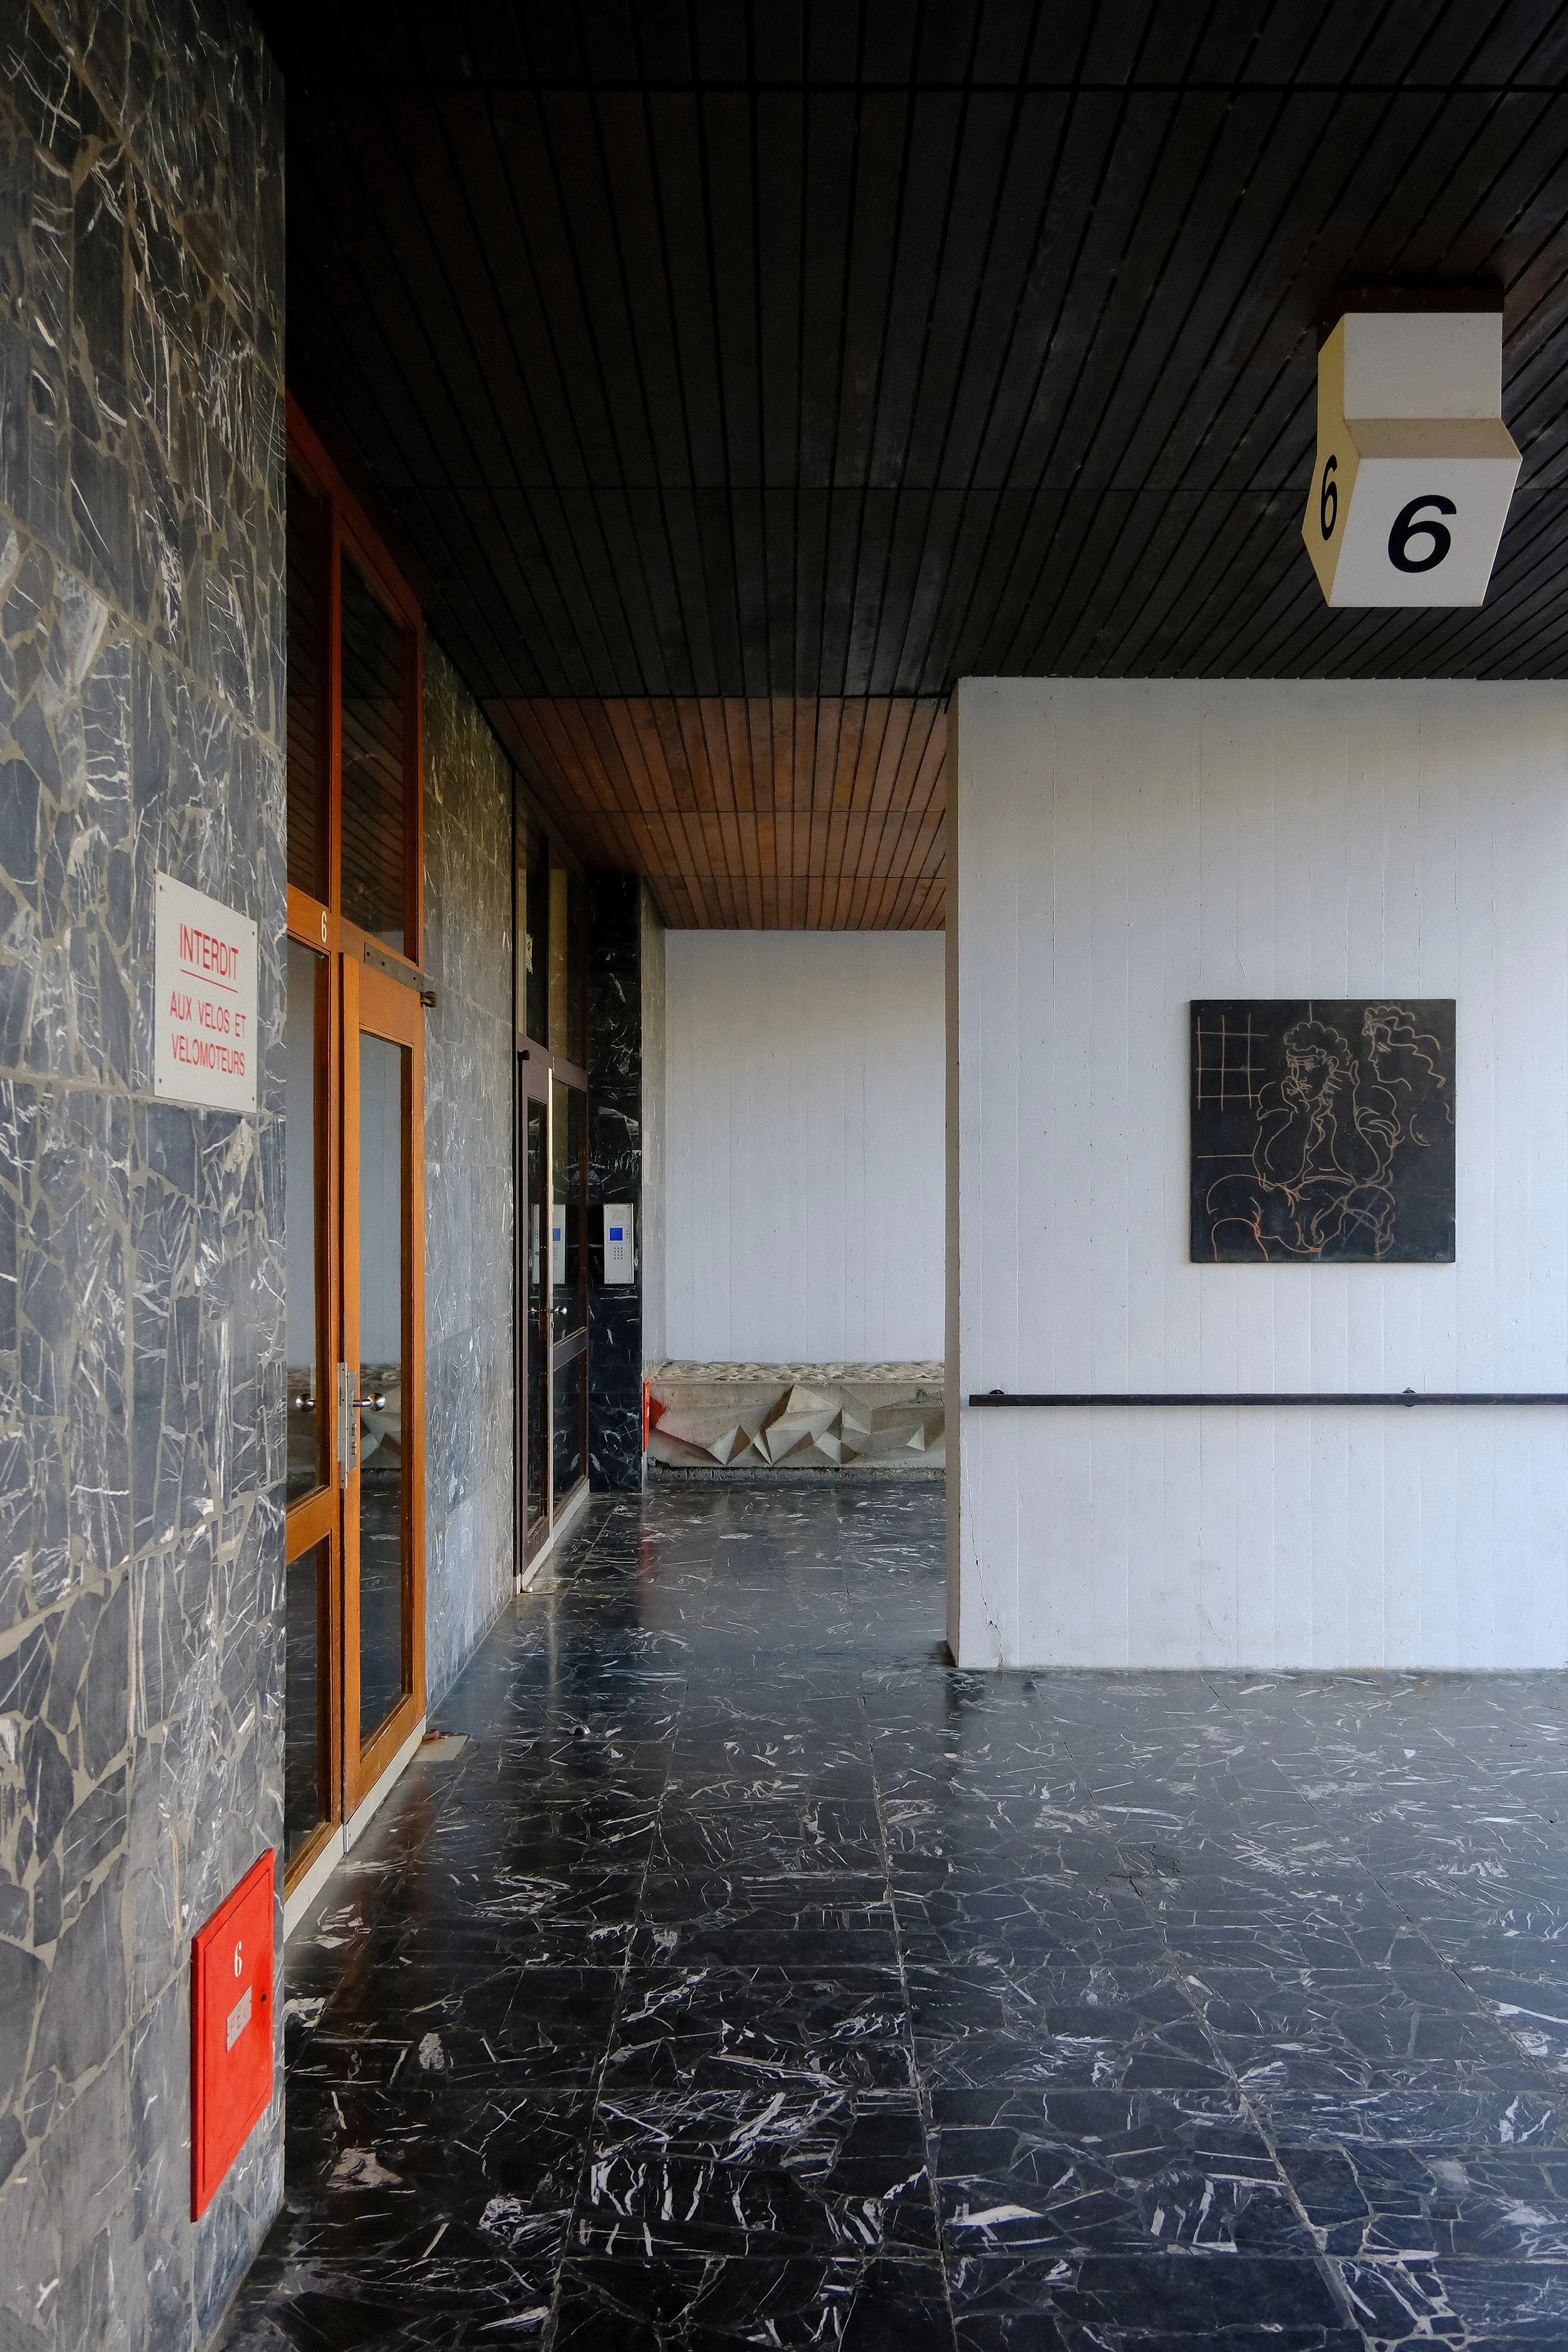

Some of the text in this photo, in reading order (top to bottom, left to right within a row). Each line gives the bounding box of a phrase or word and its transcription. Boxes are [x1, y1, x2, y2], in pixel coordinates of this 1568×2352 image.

[1320, 454, 1338, 541] 6
[1387, 494, 1457, 573] 6
[321, 910, 327, 943] 6
[179, 923, 239, 980] INTERDIT
[170, 990, 246, 1039] AUX VELOS ET
[171, 1033, 245, 1076] VELOMOTEURS
[234, 1941, 242, 1978] 6
